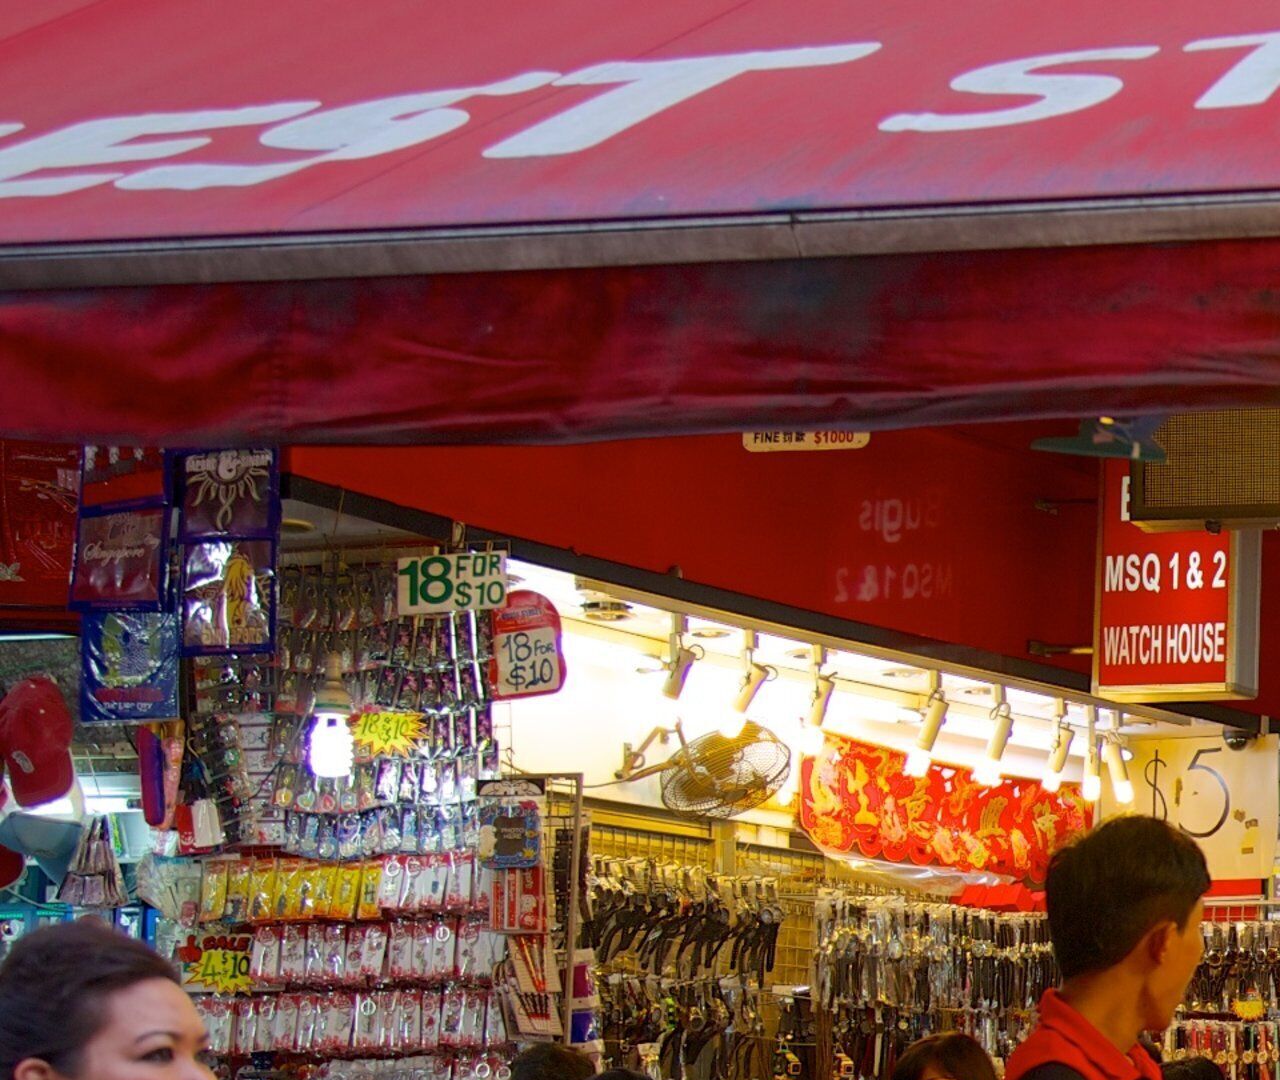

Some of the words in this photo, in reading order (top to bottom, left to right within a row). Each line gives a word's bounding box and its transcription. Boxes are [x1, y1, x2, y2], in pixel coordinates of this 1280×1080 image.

[0, 42, 881, 199] EST
[753, 431, 780, 444] FINE
[813, 430, 854, 445] $1000
[398, 556, 454, 607] 18
[455, 553, 501, 579] FOR
[1105, 553, 1161, 593] MSQ
[1168, 552, 1180, 590] 1
[1186, 551, 1204, 590] &
[1211, 550, 1227, 589] 2
[454, 580, 505, 608] $10
[501, 632, 532, 664] 18
[1104, 624, 1163, 666] WATCH
[1166, 622, 1226, 664] HOUSE
[505, 658, 553, 692] $10
[360, 712, 381, 736] 18
[1144, 746, 1231, 839] $5
